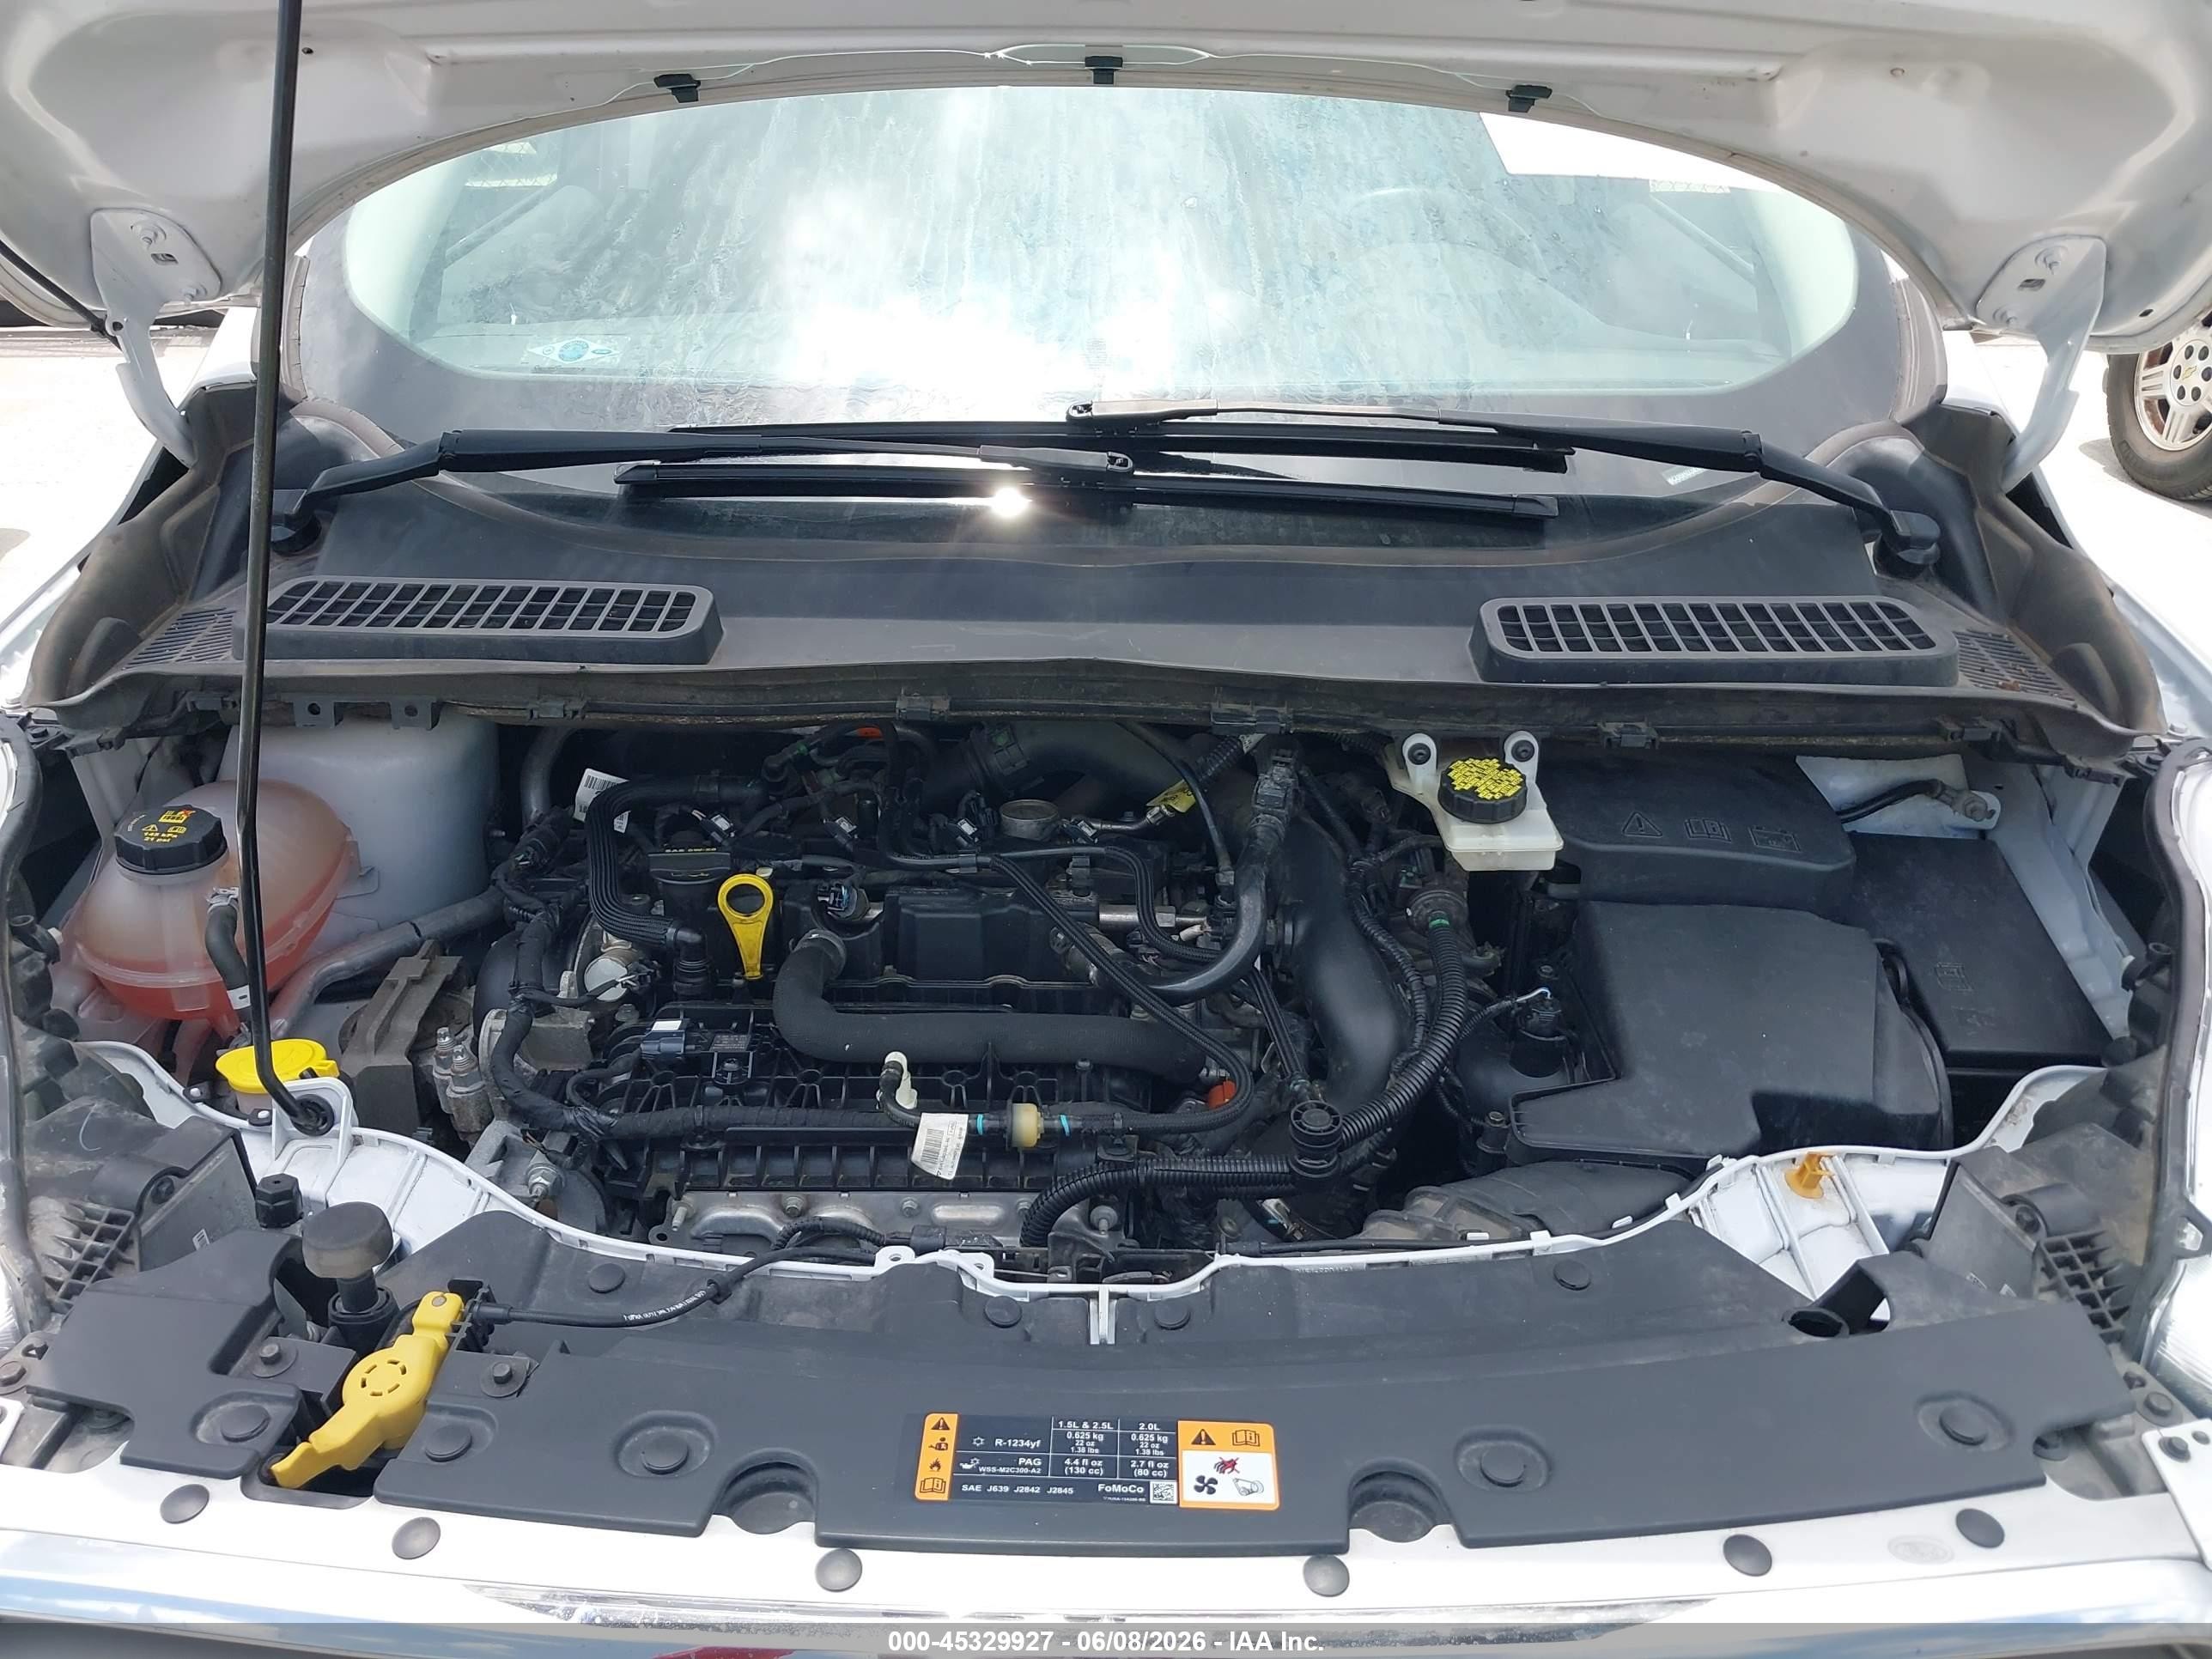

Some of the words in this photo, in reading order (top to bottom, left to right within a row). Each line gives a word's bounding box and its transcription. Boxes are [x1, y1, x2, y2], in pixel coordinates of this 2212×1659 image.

[1058, 1420, 1079, 1429] 1.5L
[1092, 1421, 1114, 1430] 2.5L
[1138, 1422, 1160, 1431] 2.0L
[1066, 1431, 1091, 1439] 0.625
[1092, 1431, 1104, 1442] kg
[1130, 1433, 1155, 1442] 0.625
[1157, 1434, 1169, 1443] kg
[994, 1438, 1042, 1449] R-1234yf
[1018, 1457, 1042, 1466] PAG
[1064, 1457, 1079, 1466] 4.4
[1147, 1460, 1154, 1468] fl
[1064, 1466, 1086, 1474] (130
[1088, 1467, 1103, 1476] cc)
[1133, 1468, 1149, 1477] (80
[1152, 1468, 1167, 1478] cc)
[1097, 1484, 1145, 1493] FoMoCo
